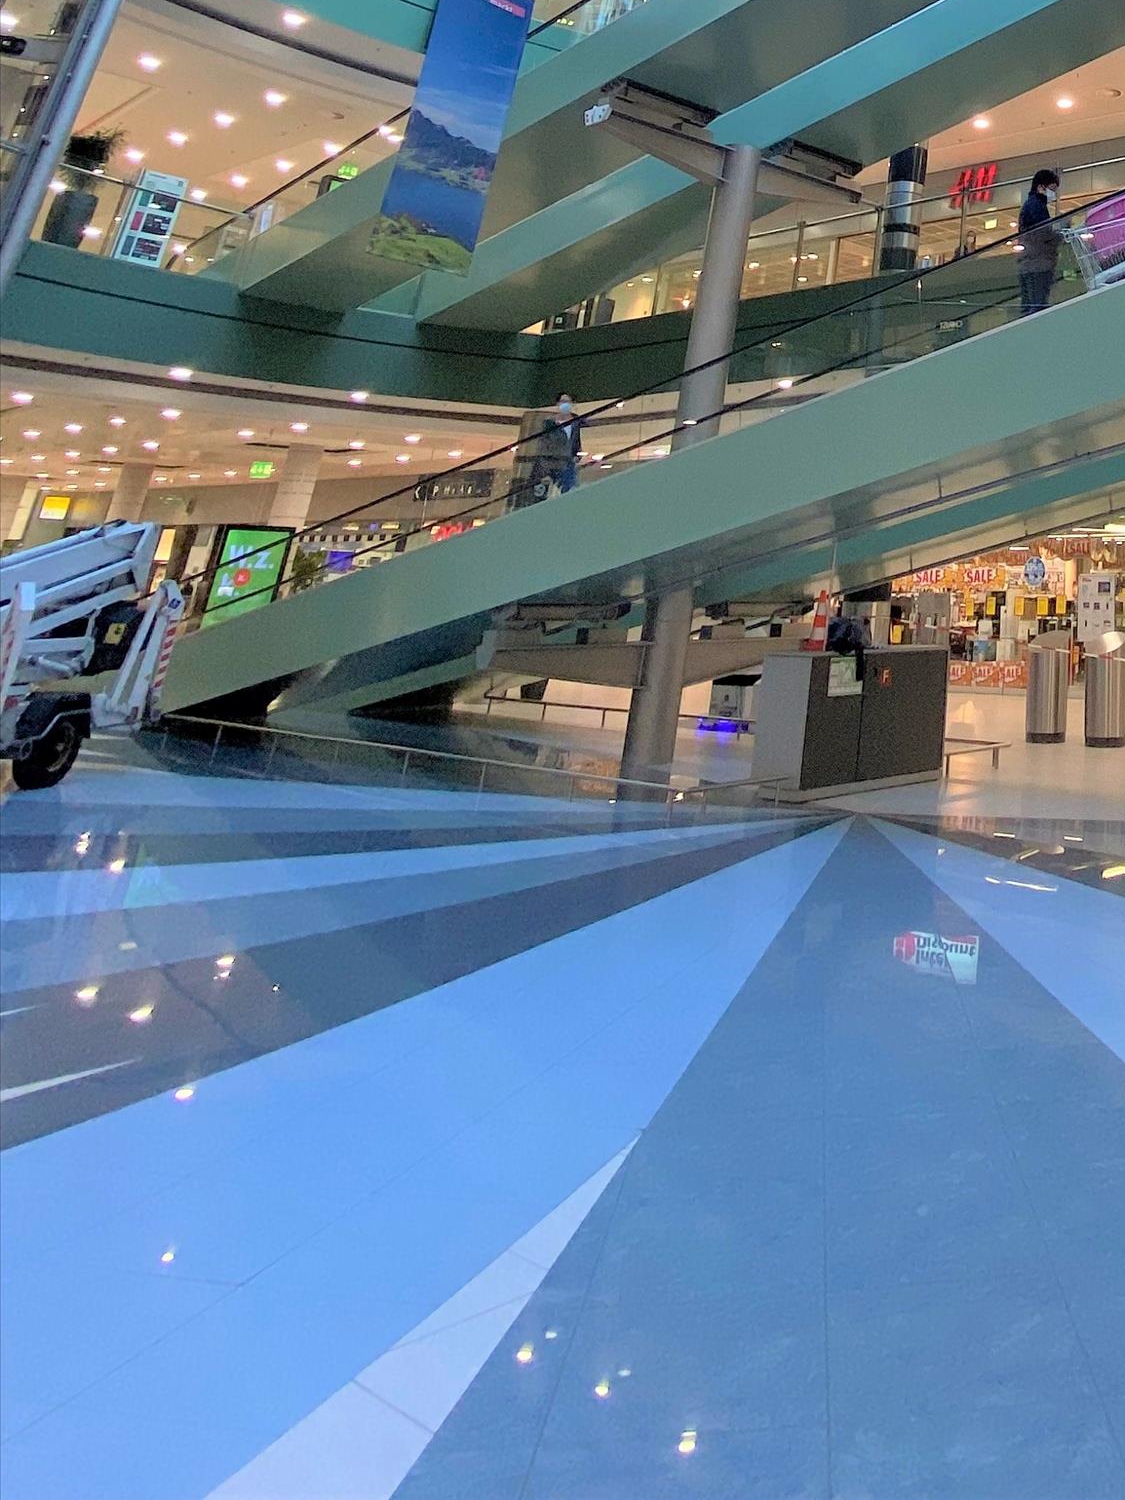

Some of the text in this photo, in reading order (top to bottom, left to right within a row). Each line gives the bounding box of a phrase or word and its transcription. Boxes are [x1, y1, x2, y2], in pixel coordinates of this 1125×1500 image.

[948, 163, 997, 209] HM
[916, 569, 941, 584] SALE
[966, 569, 993, 584] SALE
